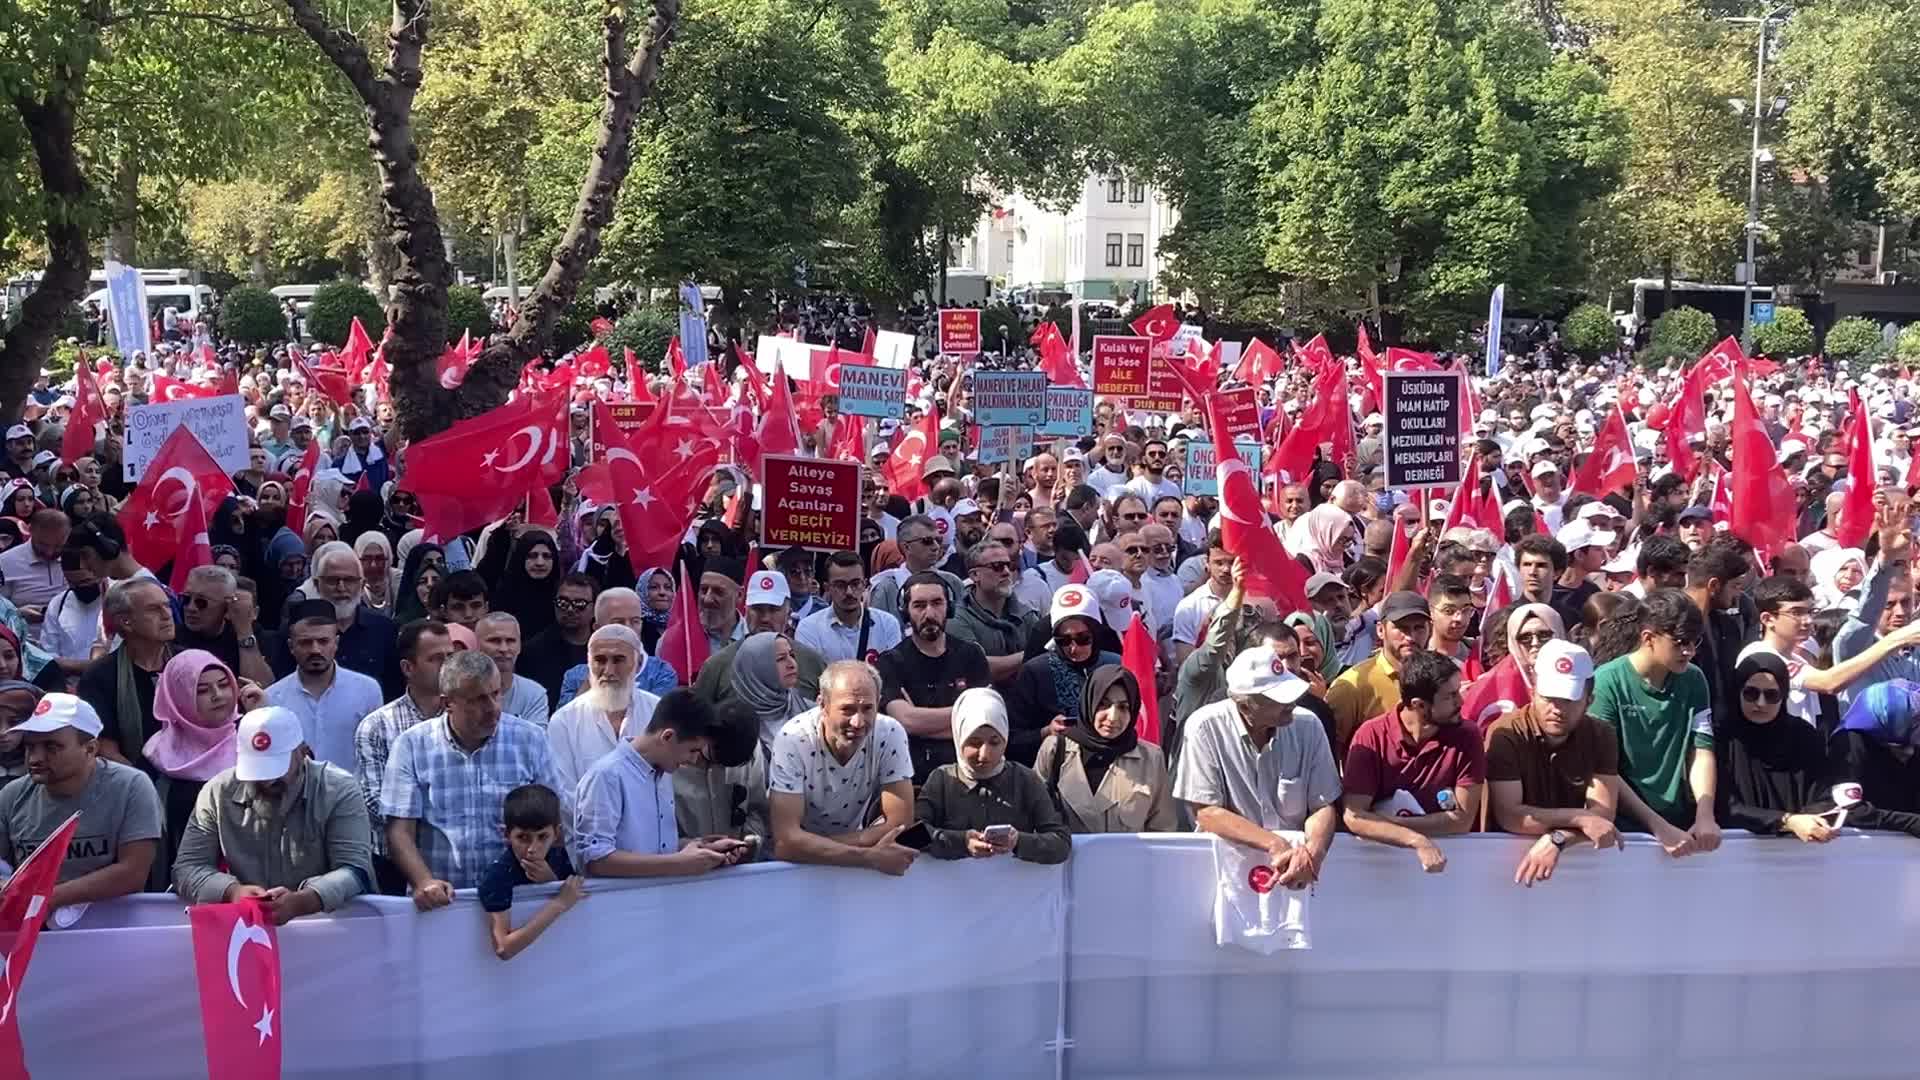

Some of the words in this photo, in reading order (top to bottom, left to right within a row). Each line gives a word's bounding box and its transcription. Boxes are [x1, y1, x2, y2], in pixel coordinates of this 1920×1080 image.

[1099, 343, 1128, 353] Kulak
[1129, 343, 1145, 354] Ver
[1103, 356, 1116, 366] Bu
[1118, 356, 1141, 367] Sese
[1110, 368, 1133, 380] AİLE
[1007, 378, 1016, 393] VE
[1096, 383, 1145, 394] HEDEFTE!
[1401, 380, 1445, 395] ÜSKÜDAR
[977, 394, 1017, 409] KALKINMA
[1048, 392, 1089, 408] PKINLIĞA
[1396, 398, 1421, 413] İMAM
[1423, 397, 1450, 413] HATİP
[1401, 417, 1446, 430] OKULLARI
[1391, 434, 1443, 448] MEZUNLARI
[1445, 435, 1456, 445] ve
[1394, 451, 1453, 465] MENSUPLARI
[788, 465, 836, 481] Aileye
[1404, 465, 1445, 481] DERNEĞİ
[789, 481, 833, 497] Savaş
[778, 497, 844, 513] Açanlara
[788, 513, 833, 529] GEÇİT
[768, 528, 851, 546] VERMEYİZ!
